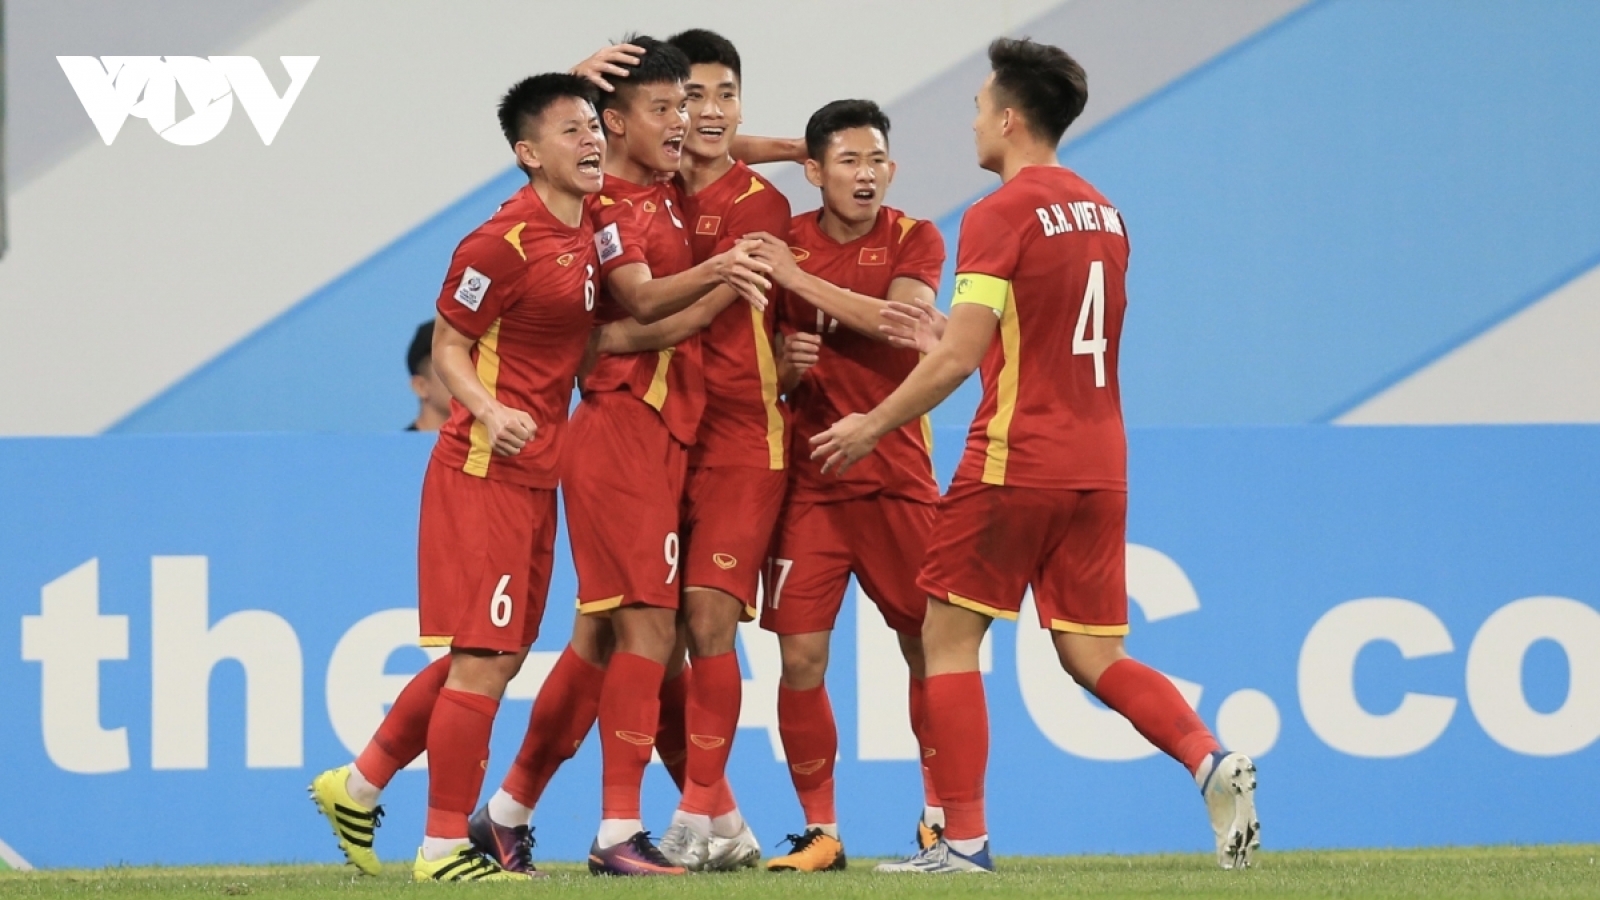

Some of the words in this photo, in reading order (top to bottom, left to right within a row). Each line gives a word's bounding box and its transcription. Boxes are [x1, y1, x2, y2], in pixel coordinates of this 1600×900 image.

[1035, 203, 1073, 237] B.H.
[1067, 201, 1101, 231] VIET
[1099, 204, 1125, 237] AN
[584, 263, 595, 312] 6
[1072, 261, 1108, 388] 4
[664, 531, 680, 585] 9
[767, 556, 794, 610] 17
[490, 574, 513, 628] 6
[20, 542, 1600, 775] the-C.co
